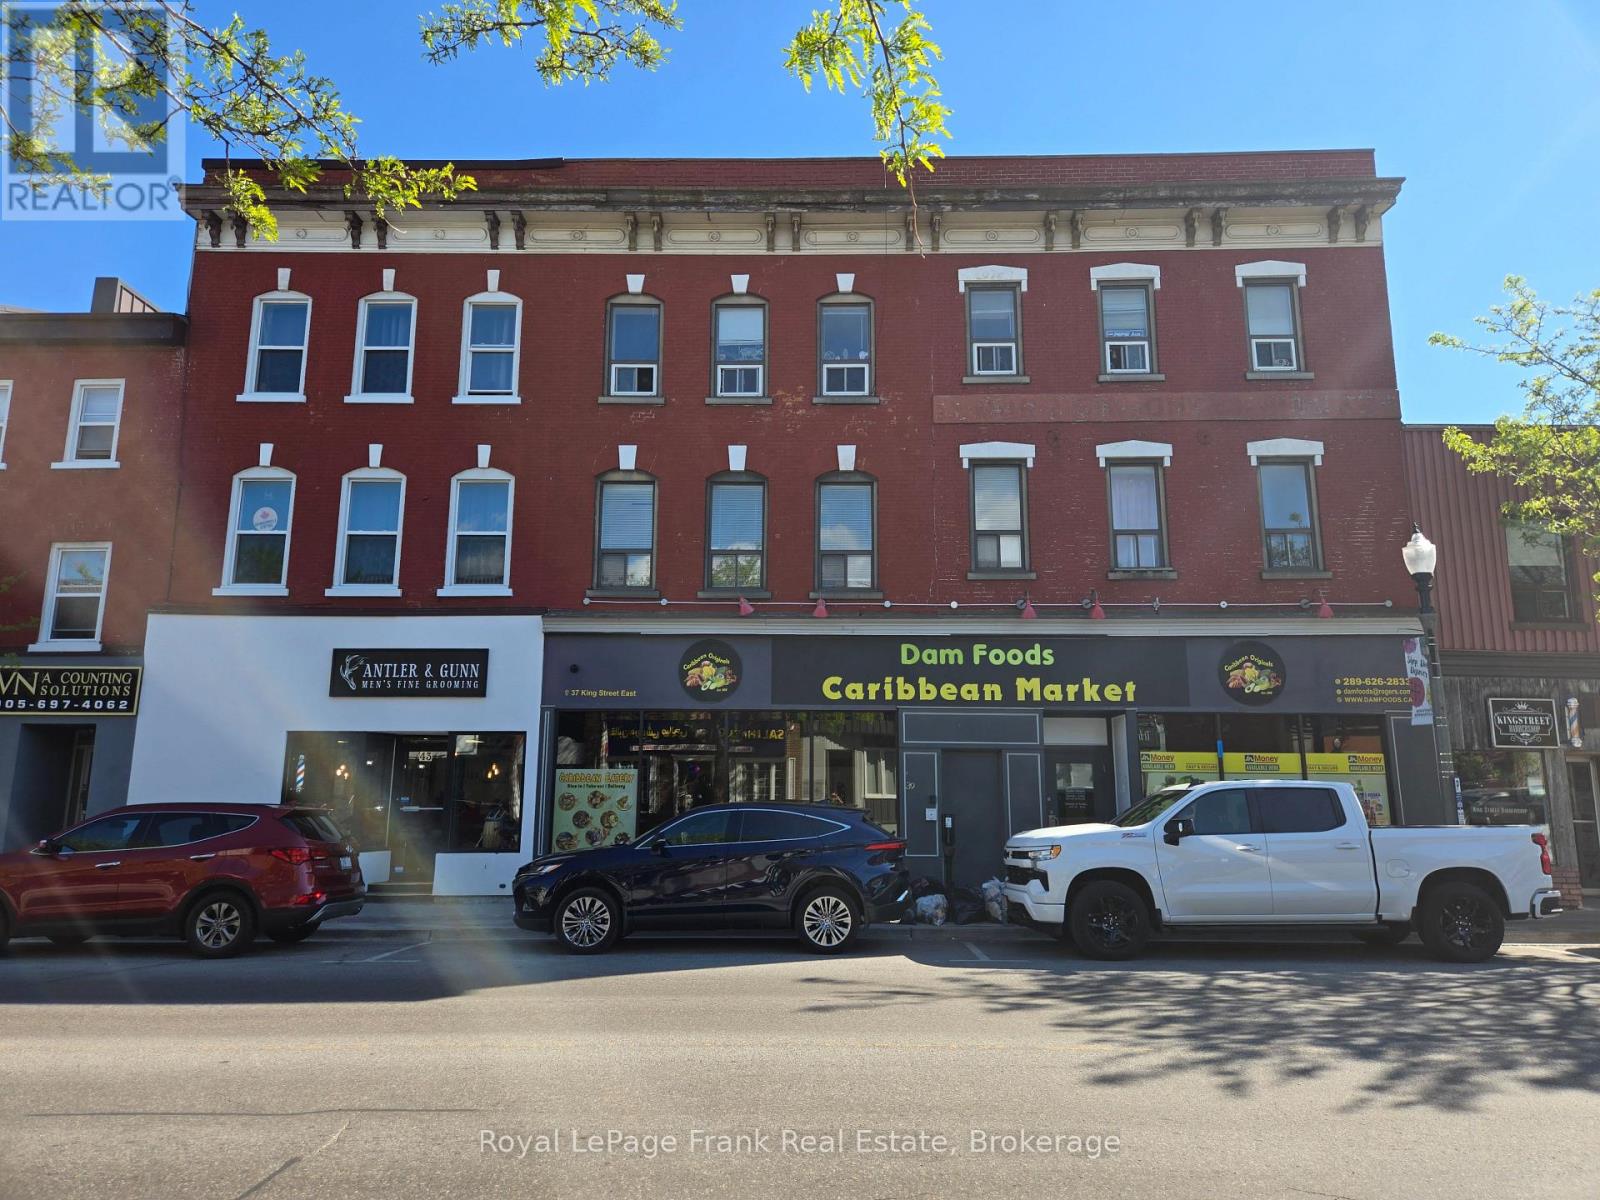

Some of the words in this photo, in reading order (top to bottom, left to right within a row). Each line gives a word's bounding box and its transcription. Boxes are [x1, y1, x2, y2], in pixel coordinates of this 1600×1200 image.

[901, 643, 964, 665] Dam
[973, 643, 1054, 665] Foods
[1225, 655, 1249, 671] Caribbean
[363, 663, 418, 678] ANTLER
[424, 663, 433, 678] &
[439, 663, 480, 678] GUNN
[41, 672, 52, 684] A
[60, 672, 132, 684] COUNTING
[362, 680, 391, 689] MEN'S
[397, 680, 420, 689] FINE
[426, 680, 480, 689] GROOMING
[822, 676, 1002, 701] Caribbean
[1016, 676, 1136, 702] Market
[40, 685, 131, 696] SOLUTIONS
[581, 690, 597, 698] King
[0, 700, 128, 709] 05-697-4062
[1497, 716, 1550, 725] KINGSTREET
[419, 752, 432, 760] 45
[1151, 754, 1174, 762] Money
[1254, 755, 1278, 763] Money
